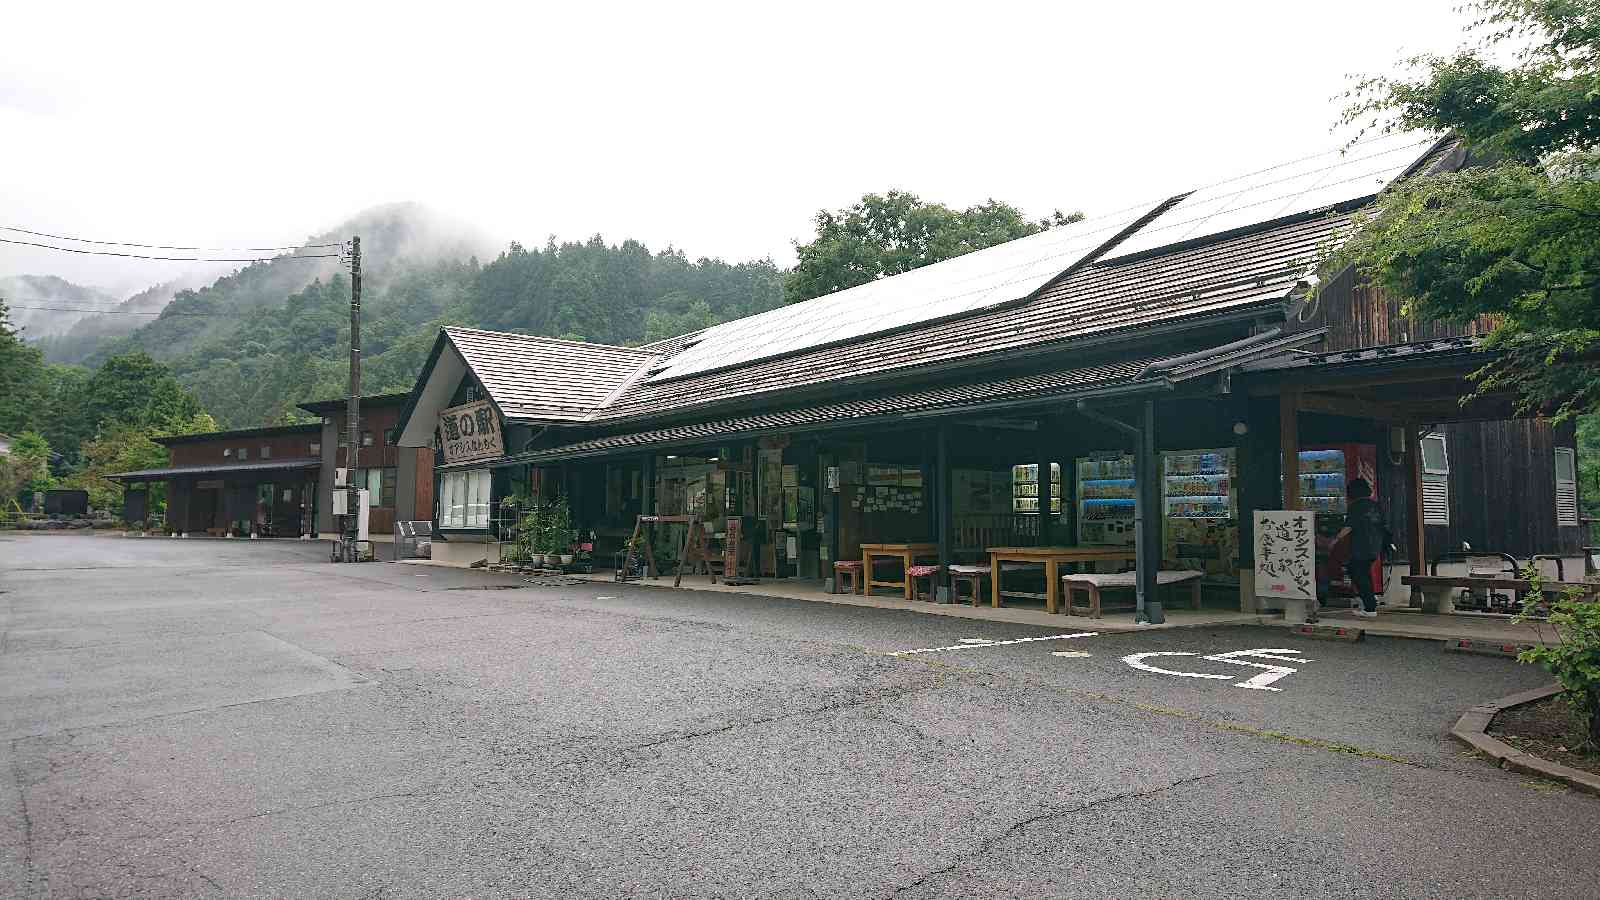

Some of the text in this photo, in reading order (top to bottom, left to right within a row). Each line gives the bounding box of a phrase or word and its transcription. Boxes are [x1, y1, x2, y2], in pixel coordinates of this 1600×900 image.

[442, 407, 495, 440] 道の駅
[1275, 520, 1295, 577] 道の駅
